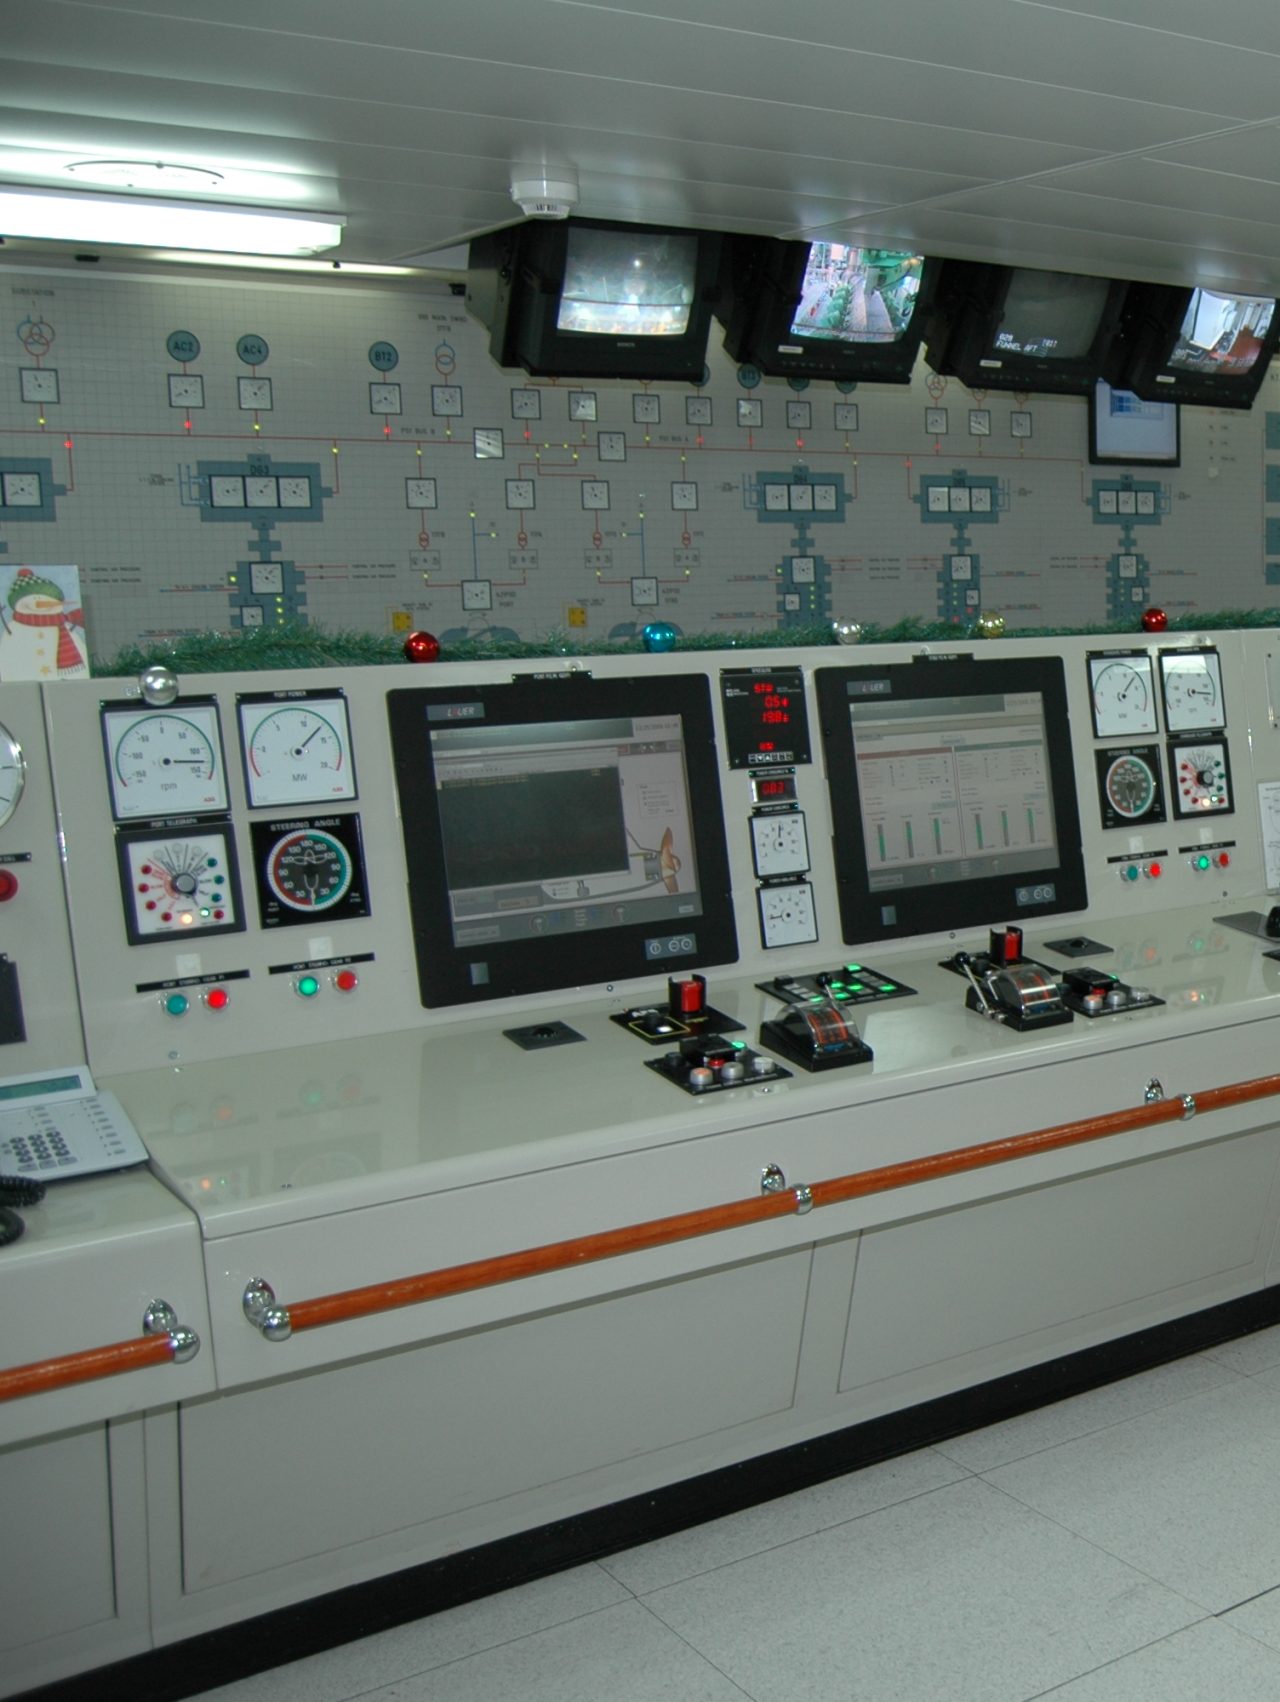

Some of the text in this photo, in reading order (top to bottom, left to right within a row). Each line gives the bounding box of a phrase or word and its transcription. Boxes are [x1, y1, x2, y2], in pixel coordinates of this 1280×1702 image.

[172, 341, 194, 352] AC2
[375, 351, 392, 362] BT2
[178, 731, 187, 740] 50
[189, 747, 200, 755] 100
[292, 773, 308, 781] MW
[161, 782, 177, 791] rpm
[270, 818, 341, 832] STEERING ANGLE
